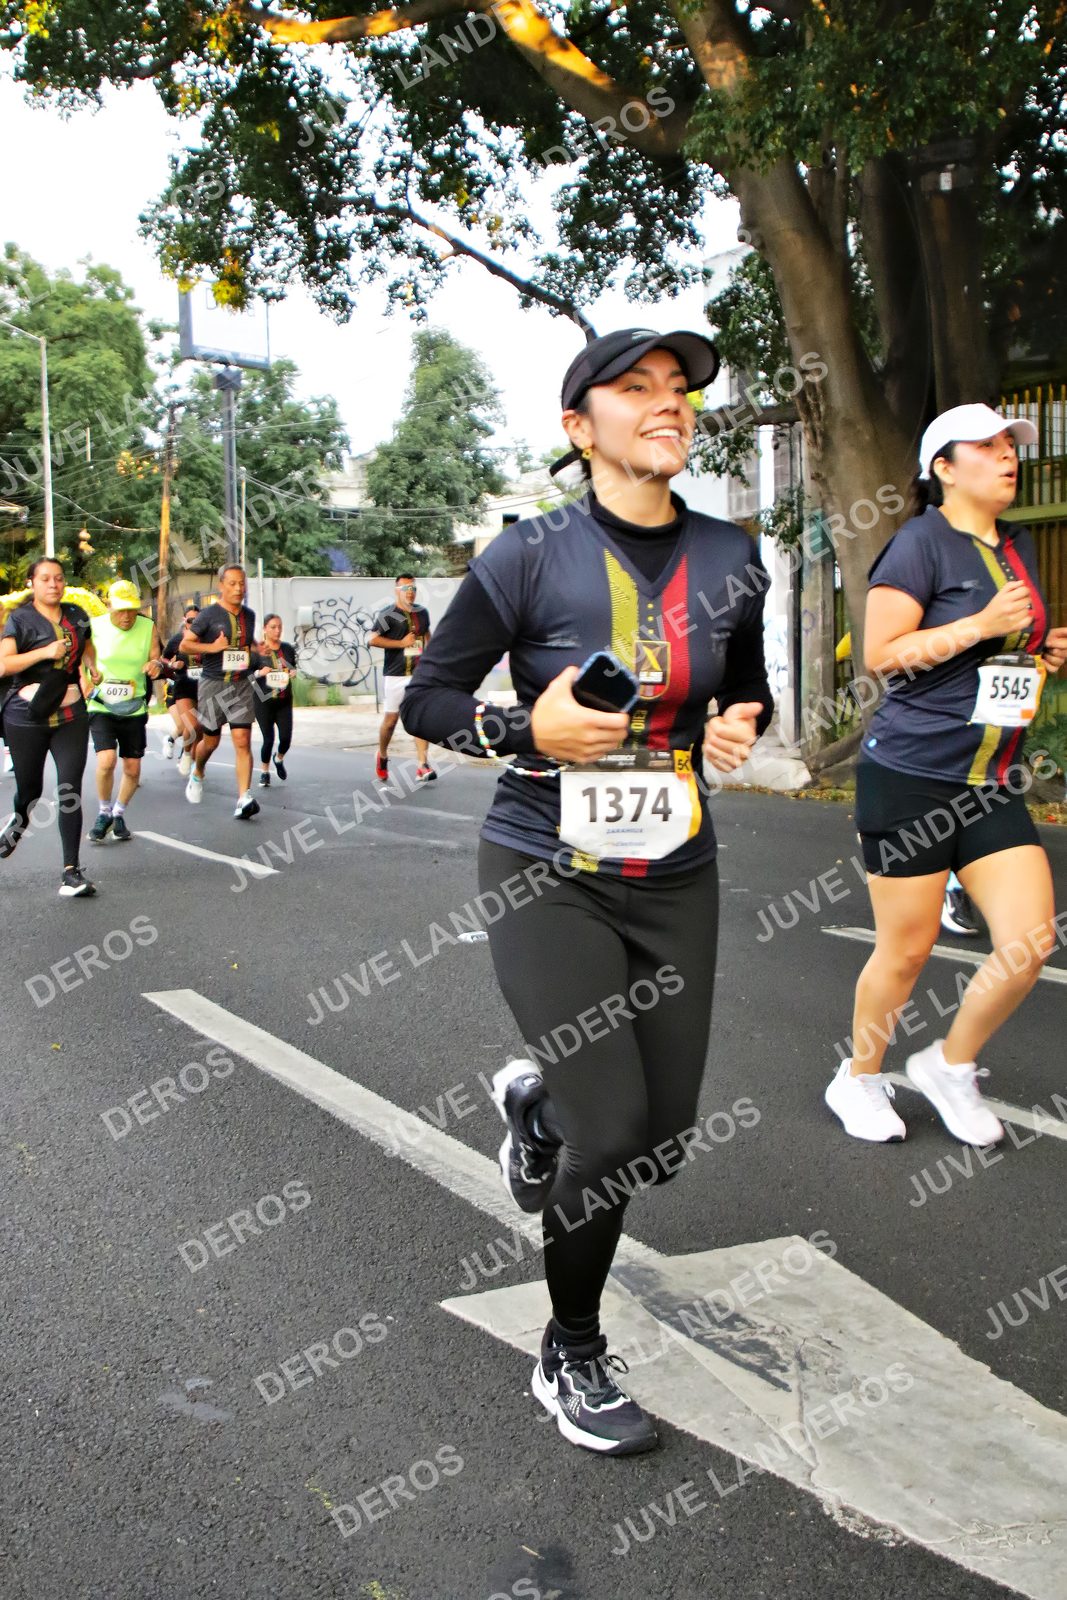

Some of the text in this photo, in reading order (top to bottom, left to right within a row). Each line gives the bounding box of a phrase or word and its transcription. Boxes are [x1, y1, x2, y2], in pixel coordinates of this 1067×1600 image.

[227, 653, 245, 663] 3304
[106, 687, 128, 697] 6073
[990, 675, 1031, 700] 5545
[581, 786, 672, 823] 1374
